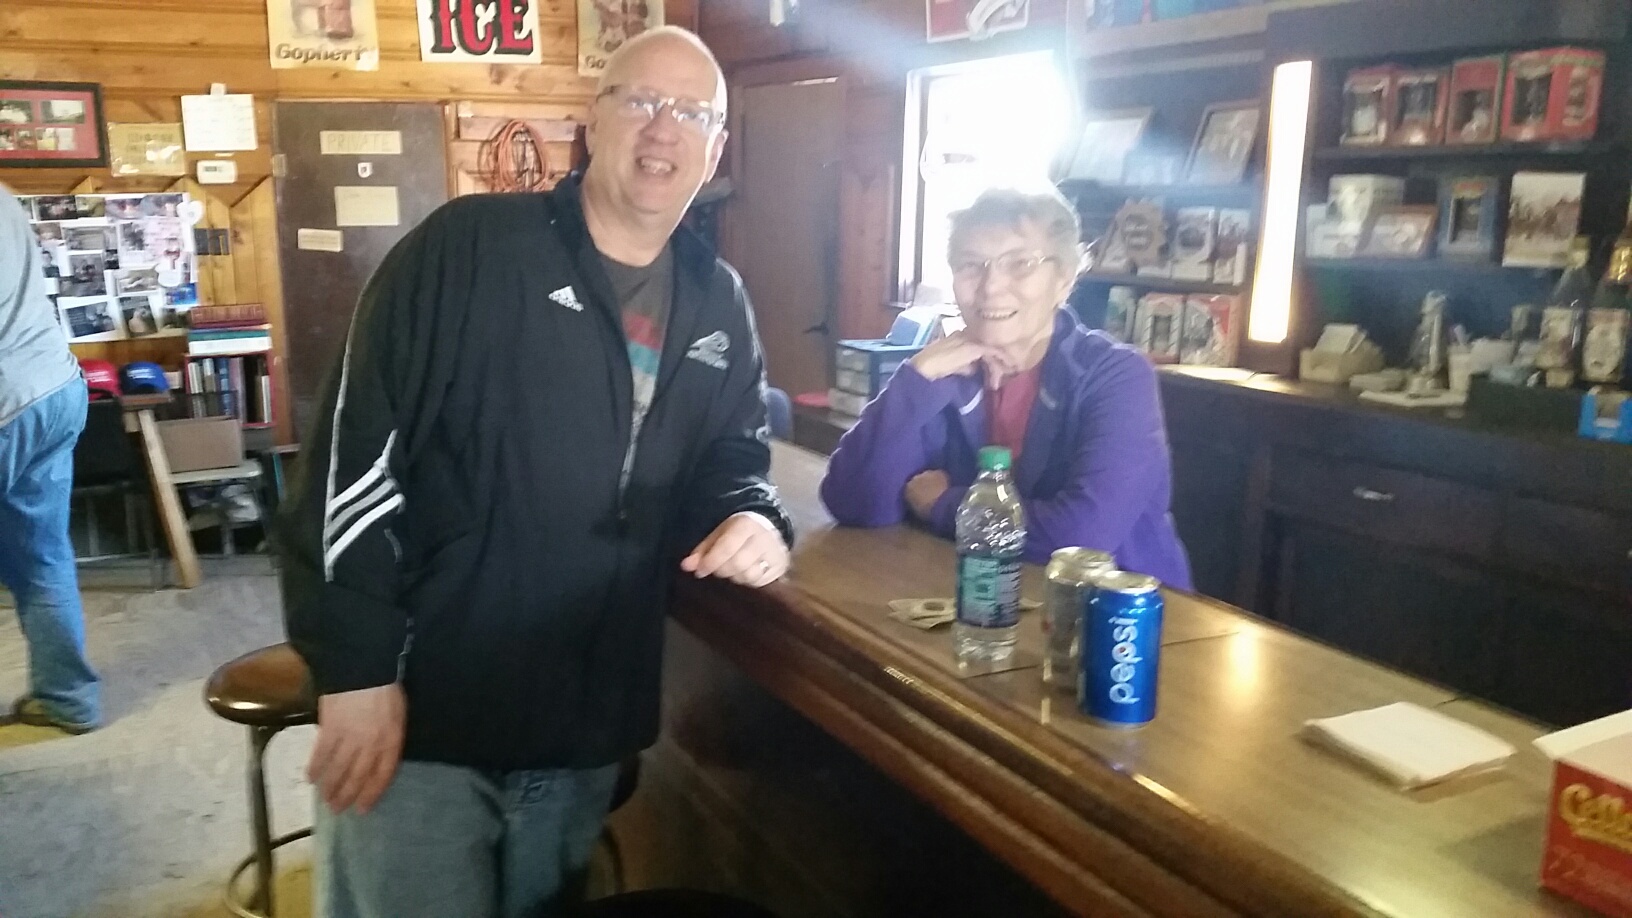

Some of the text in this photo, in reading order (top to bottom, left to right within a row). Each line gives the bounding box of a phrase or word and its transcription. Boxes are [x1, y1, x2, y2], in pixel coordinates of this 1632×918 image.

[429, 0, 534, 55] ICE
[327, 133, 393, 152] PRIVATE
[1108, 616, 1144, 704] pepsi
